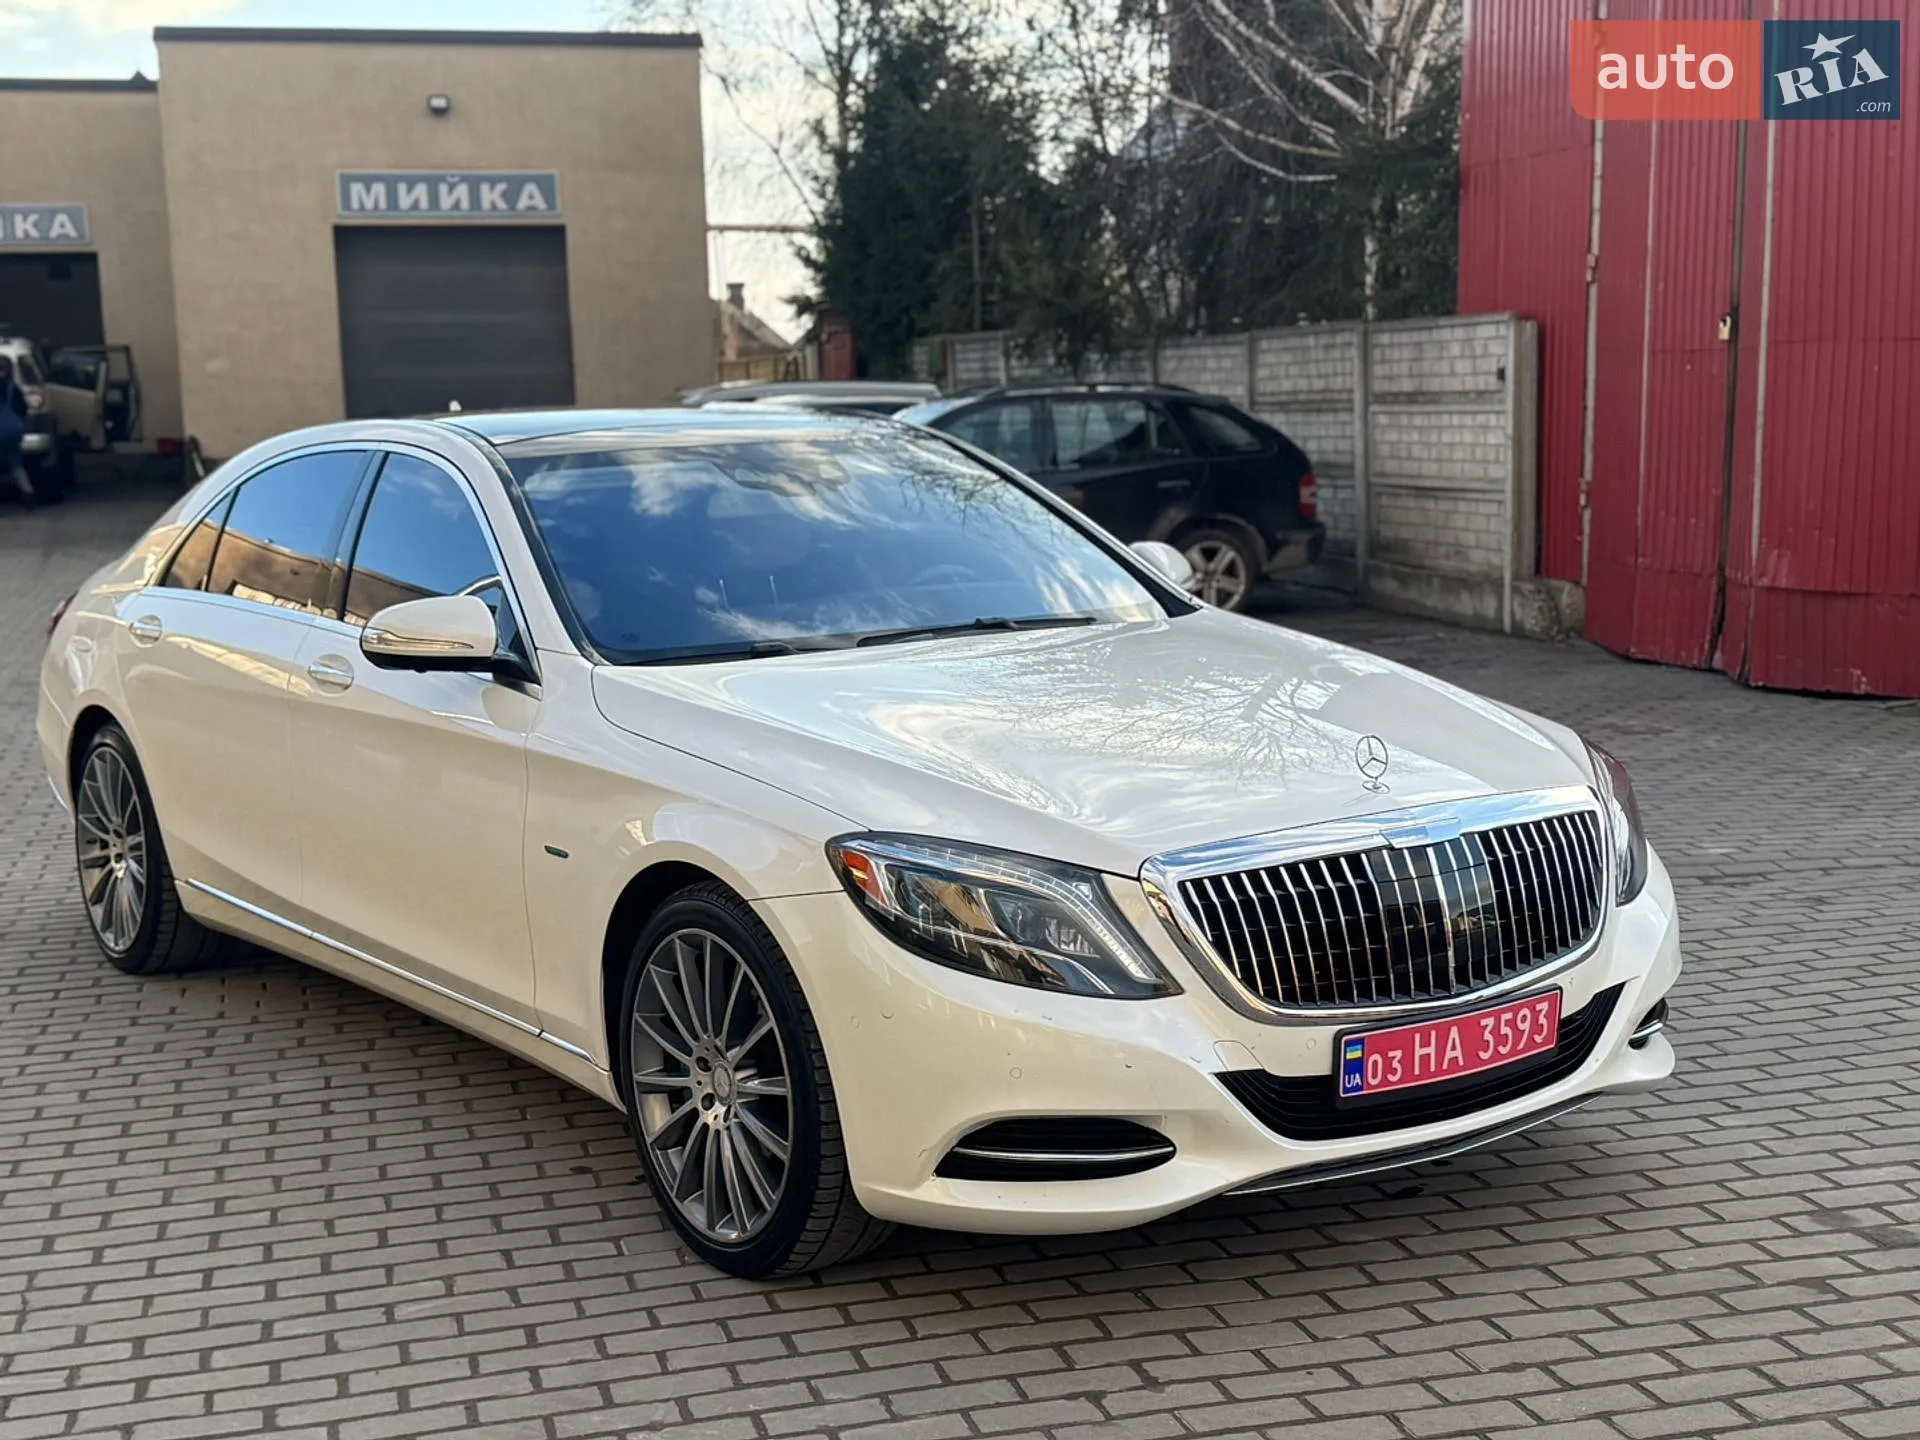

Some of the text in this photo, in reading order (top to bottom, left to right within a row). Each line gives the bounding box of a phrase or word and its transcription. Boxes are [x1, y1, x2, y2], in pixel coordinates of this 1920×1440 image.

[349, 176, 549, 211] МИЙКА
[0, 213, 79, 240] КА
[1367, 1050, 1403, 1086] 03
[1477, 1001, 1549, 1060] 3593
[1345, 1073, 1362, 1088] UA
